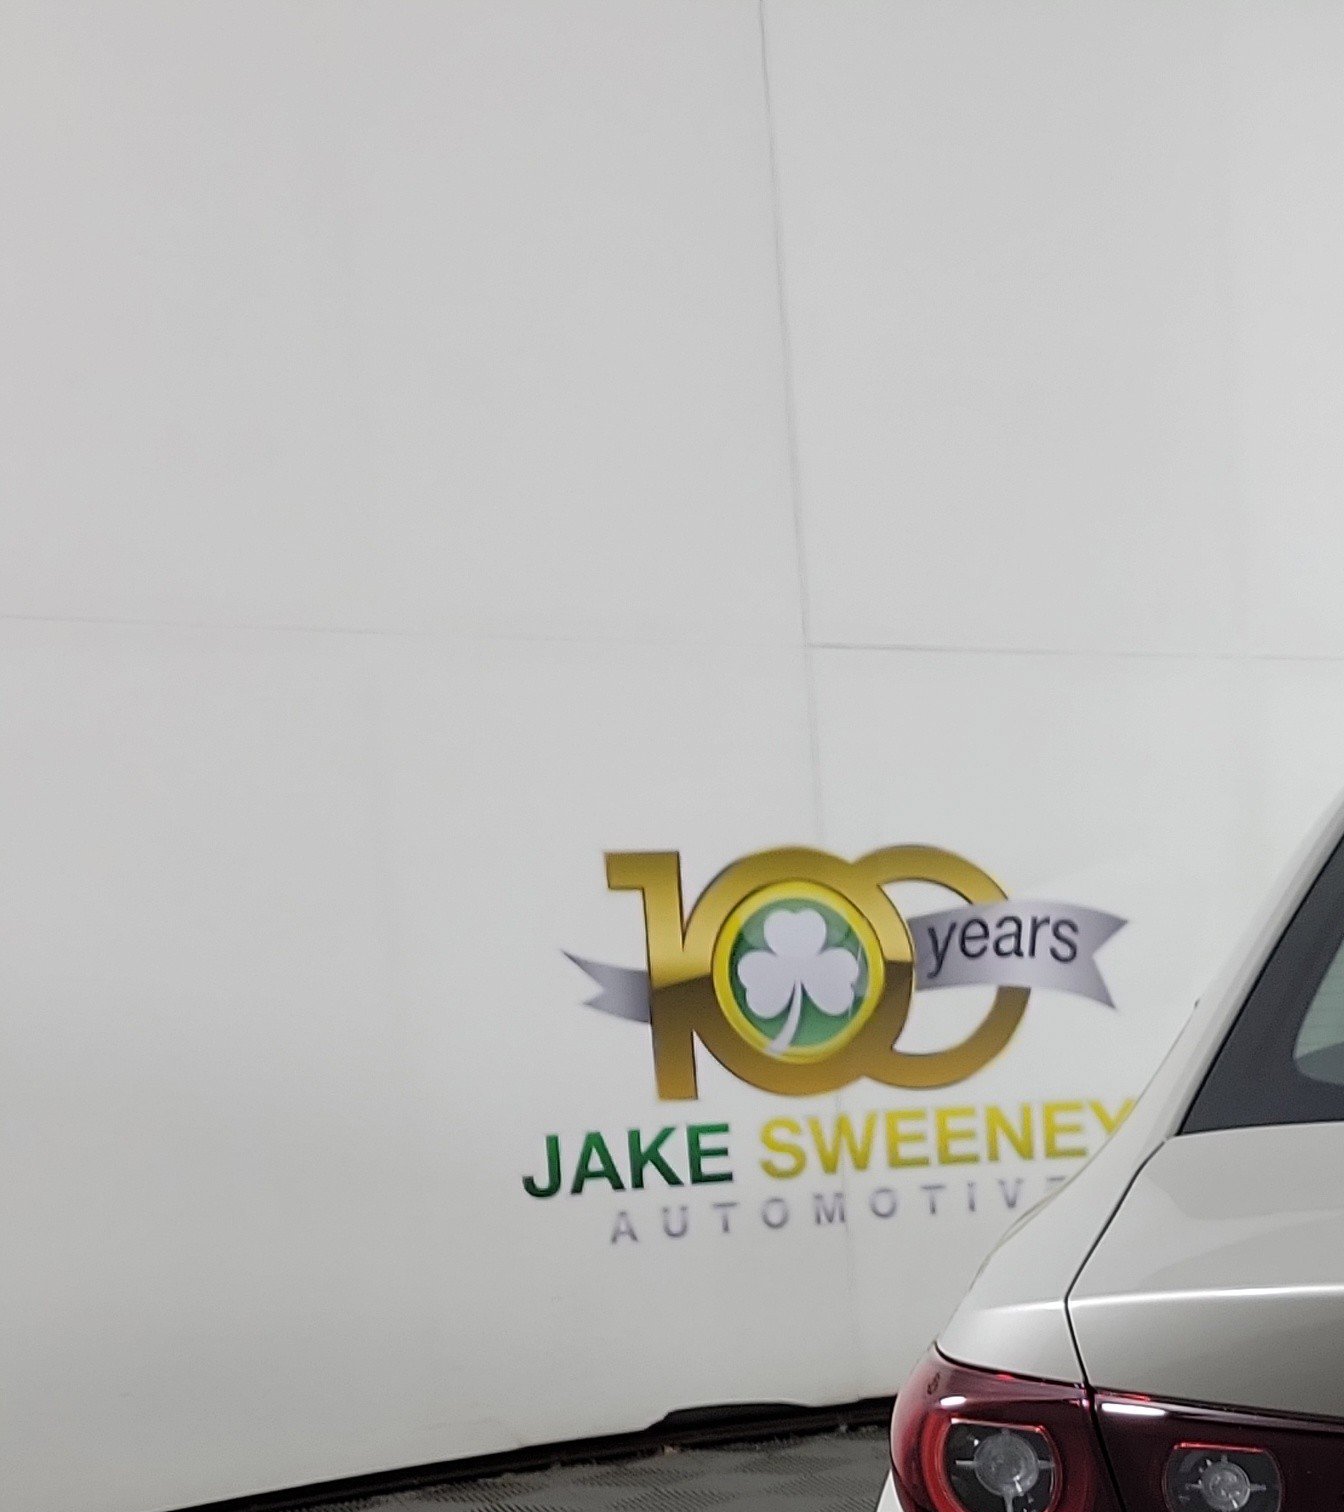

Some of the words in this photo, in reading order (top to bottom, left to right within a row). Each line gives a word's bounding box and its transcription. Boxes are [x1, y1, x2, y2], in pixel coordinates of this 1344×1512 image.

[604, 844, 1031, 1101] 100
[926, 912, 1079, 979] years
[522, 1123, 734, 1199] JAKE
[610, 1175, 1072, 1245] AUTOMOTIV
